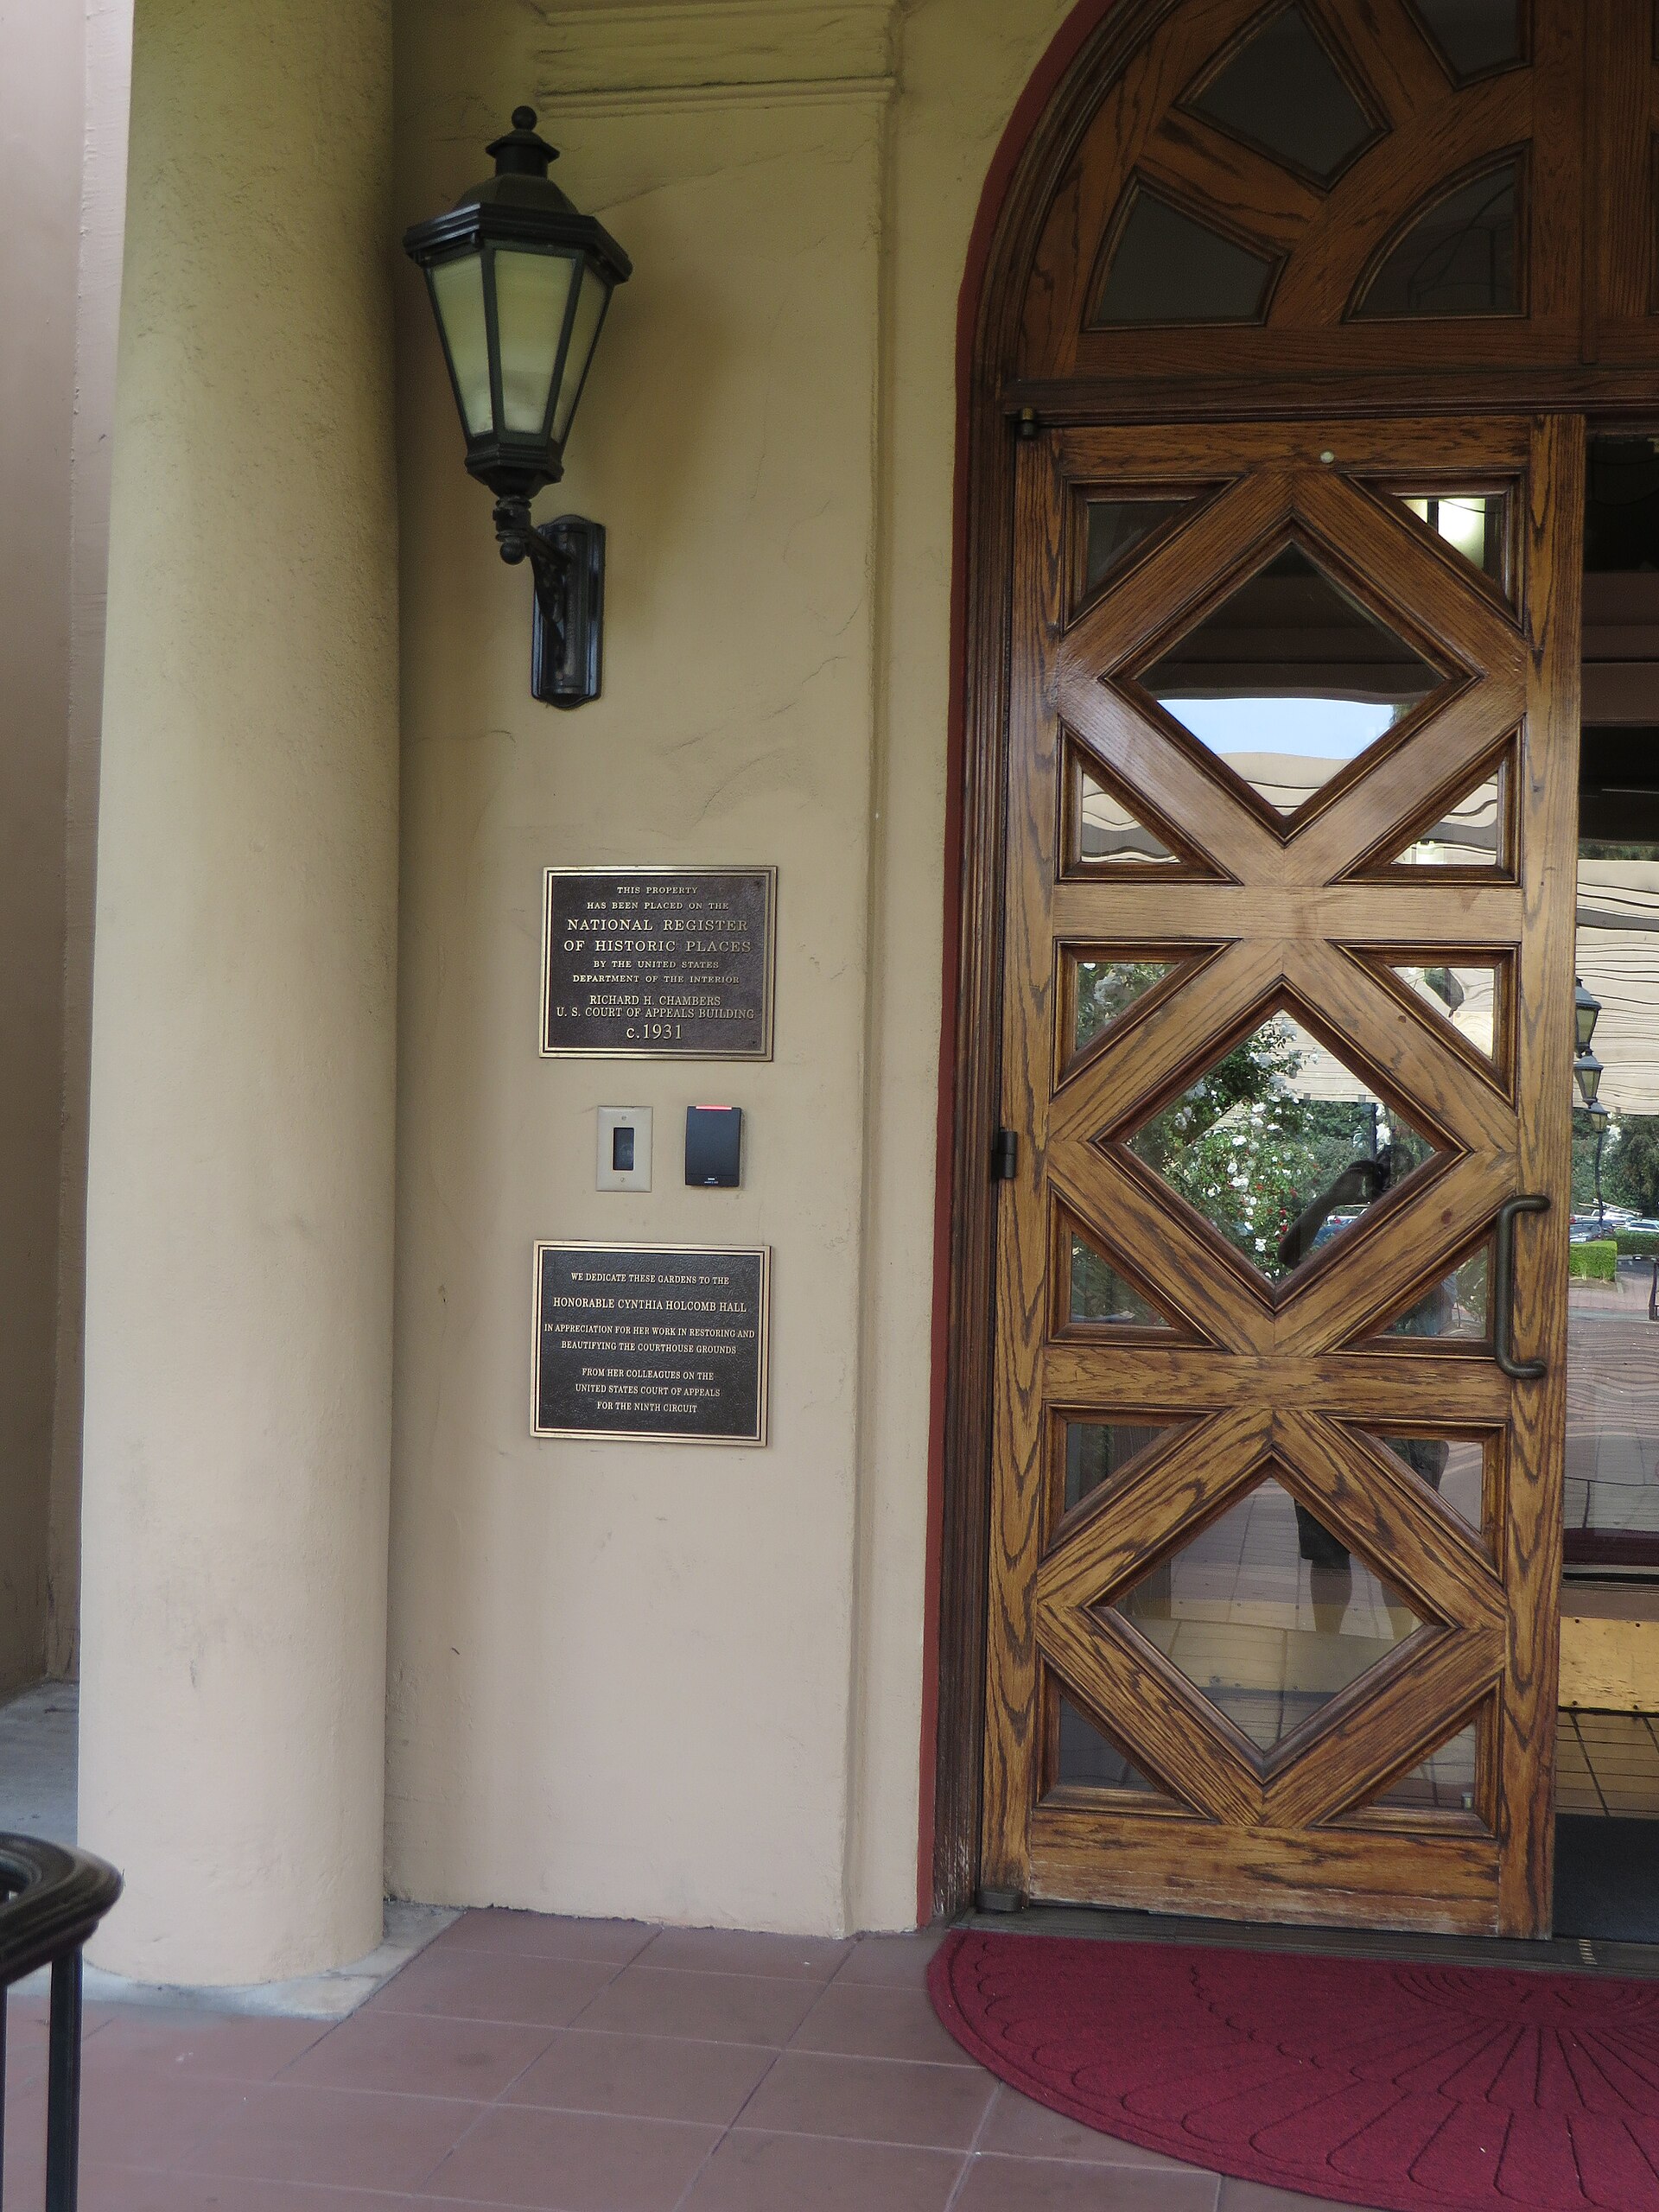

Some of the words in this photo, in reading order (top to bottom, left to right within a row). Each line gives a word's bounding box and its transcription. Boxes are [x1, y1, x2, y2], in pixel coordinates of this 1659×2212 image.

[568, 919, 653, 931] NATIONAL
[663, 919, 747, 931] REGISTER
[564, 940, 585, 951] OF
[594, 940, 676, 952] HISTORIC
[685, 941, 751, 953] PLACES
[573, 975, 639, 983] DEPARTMENT
[589, 995, 639, 1006] RICHARD
[644, 995, 655, 1006] H.
[659, 996, 721, 1006] CHAMBERS
[556, 1007, 568, 1017] U.
[571, 1007, 582, 1017] S.
[585, 1007, 622, 1018] COURT
[626, 1008, 641, 1018] OF
[645, 1008, 695, 1019] APPEALS
[698, 1009, 754, 1020] BUILDING
[626, 1024, 683, 1039] c.1931
[571, 1272, 584, 1281] WE
[585, 1273, 626, 1282] DEDICATE
[629, 1274, 656, 1283] THESE
[658, 1274, 697, 1284] GARDENS
[699, 1275, 710, 1285] TO
[713, 1276, 729, 1285] THE
[553, 1297, 615, 1309] HONORABLE
[618, 1299, 664, 1310] CYNTHIA
[665, 1300, 716, 1312] HOLCOMB
[719, 1302, 747, 1313] HALL
[544, 1324, 554, 1332] IN
[555, 1324, 613, 1334] APPRECIATION
[615, 1325, 632, 1335] FOR
[633, 1326, 650, 1335] HER
[652, 1326, 676, 1336] WORK
[677, 1327, 688, 1336] IN
[690, 1328, 735, 1338] RESTORING
[737, 1329, 755, 1338] AND
[561, 1341, 617, 1351] BEAUTIFYING
[619, 1342, 635, 1351] THE
[638, 1343, 694, 1353] COURTHOUSE
[696, 1344, 736, 1354] GROUNDS
[582, 1368, 605, 1376] FROM
[607, 1369, 625, 1377] HER
[626, 1370, 681, 1379] COLLEAGUES
[683, 1371, 695, 1380] ON
[697, 1372, 715, 1381] THE
[575, 1384, 607, 1393] UNITED
[608, 1385, 639, 1394] STATES
[640, 1386, 669, 1395] COURT
[671, 1387, 683, 1395] OF
[683, 1388, 721, 1397] APPEALS
[597, 1402, 613, 1410] FOR
[615, 1402, 632, 1410] THE
[634, 1402, 661, 1411] NINTH
[663, 1403, 698, 1413] CIRCUIT
